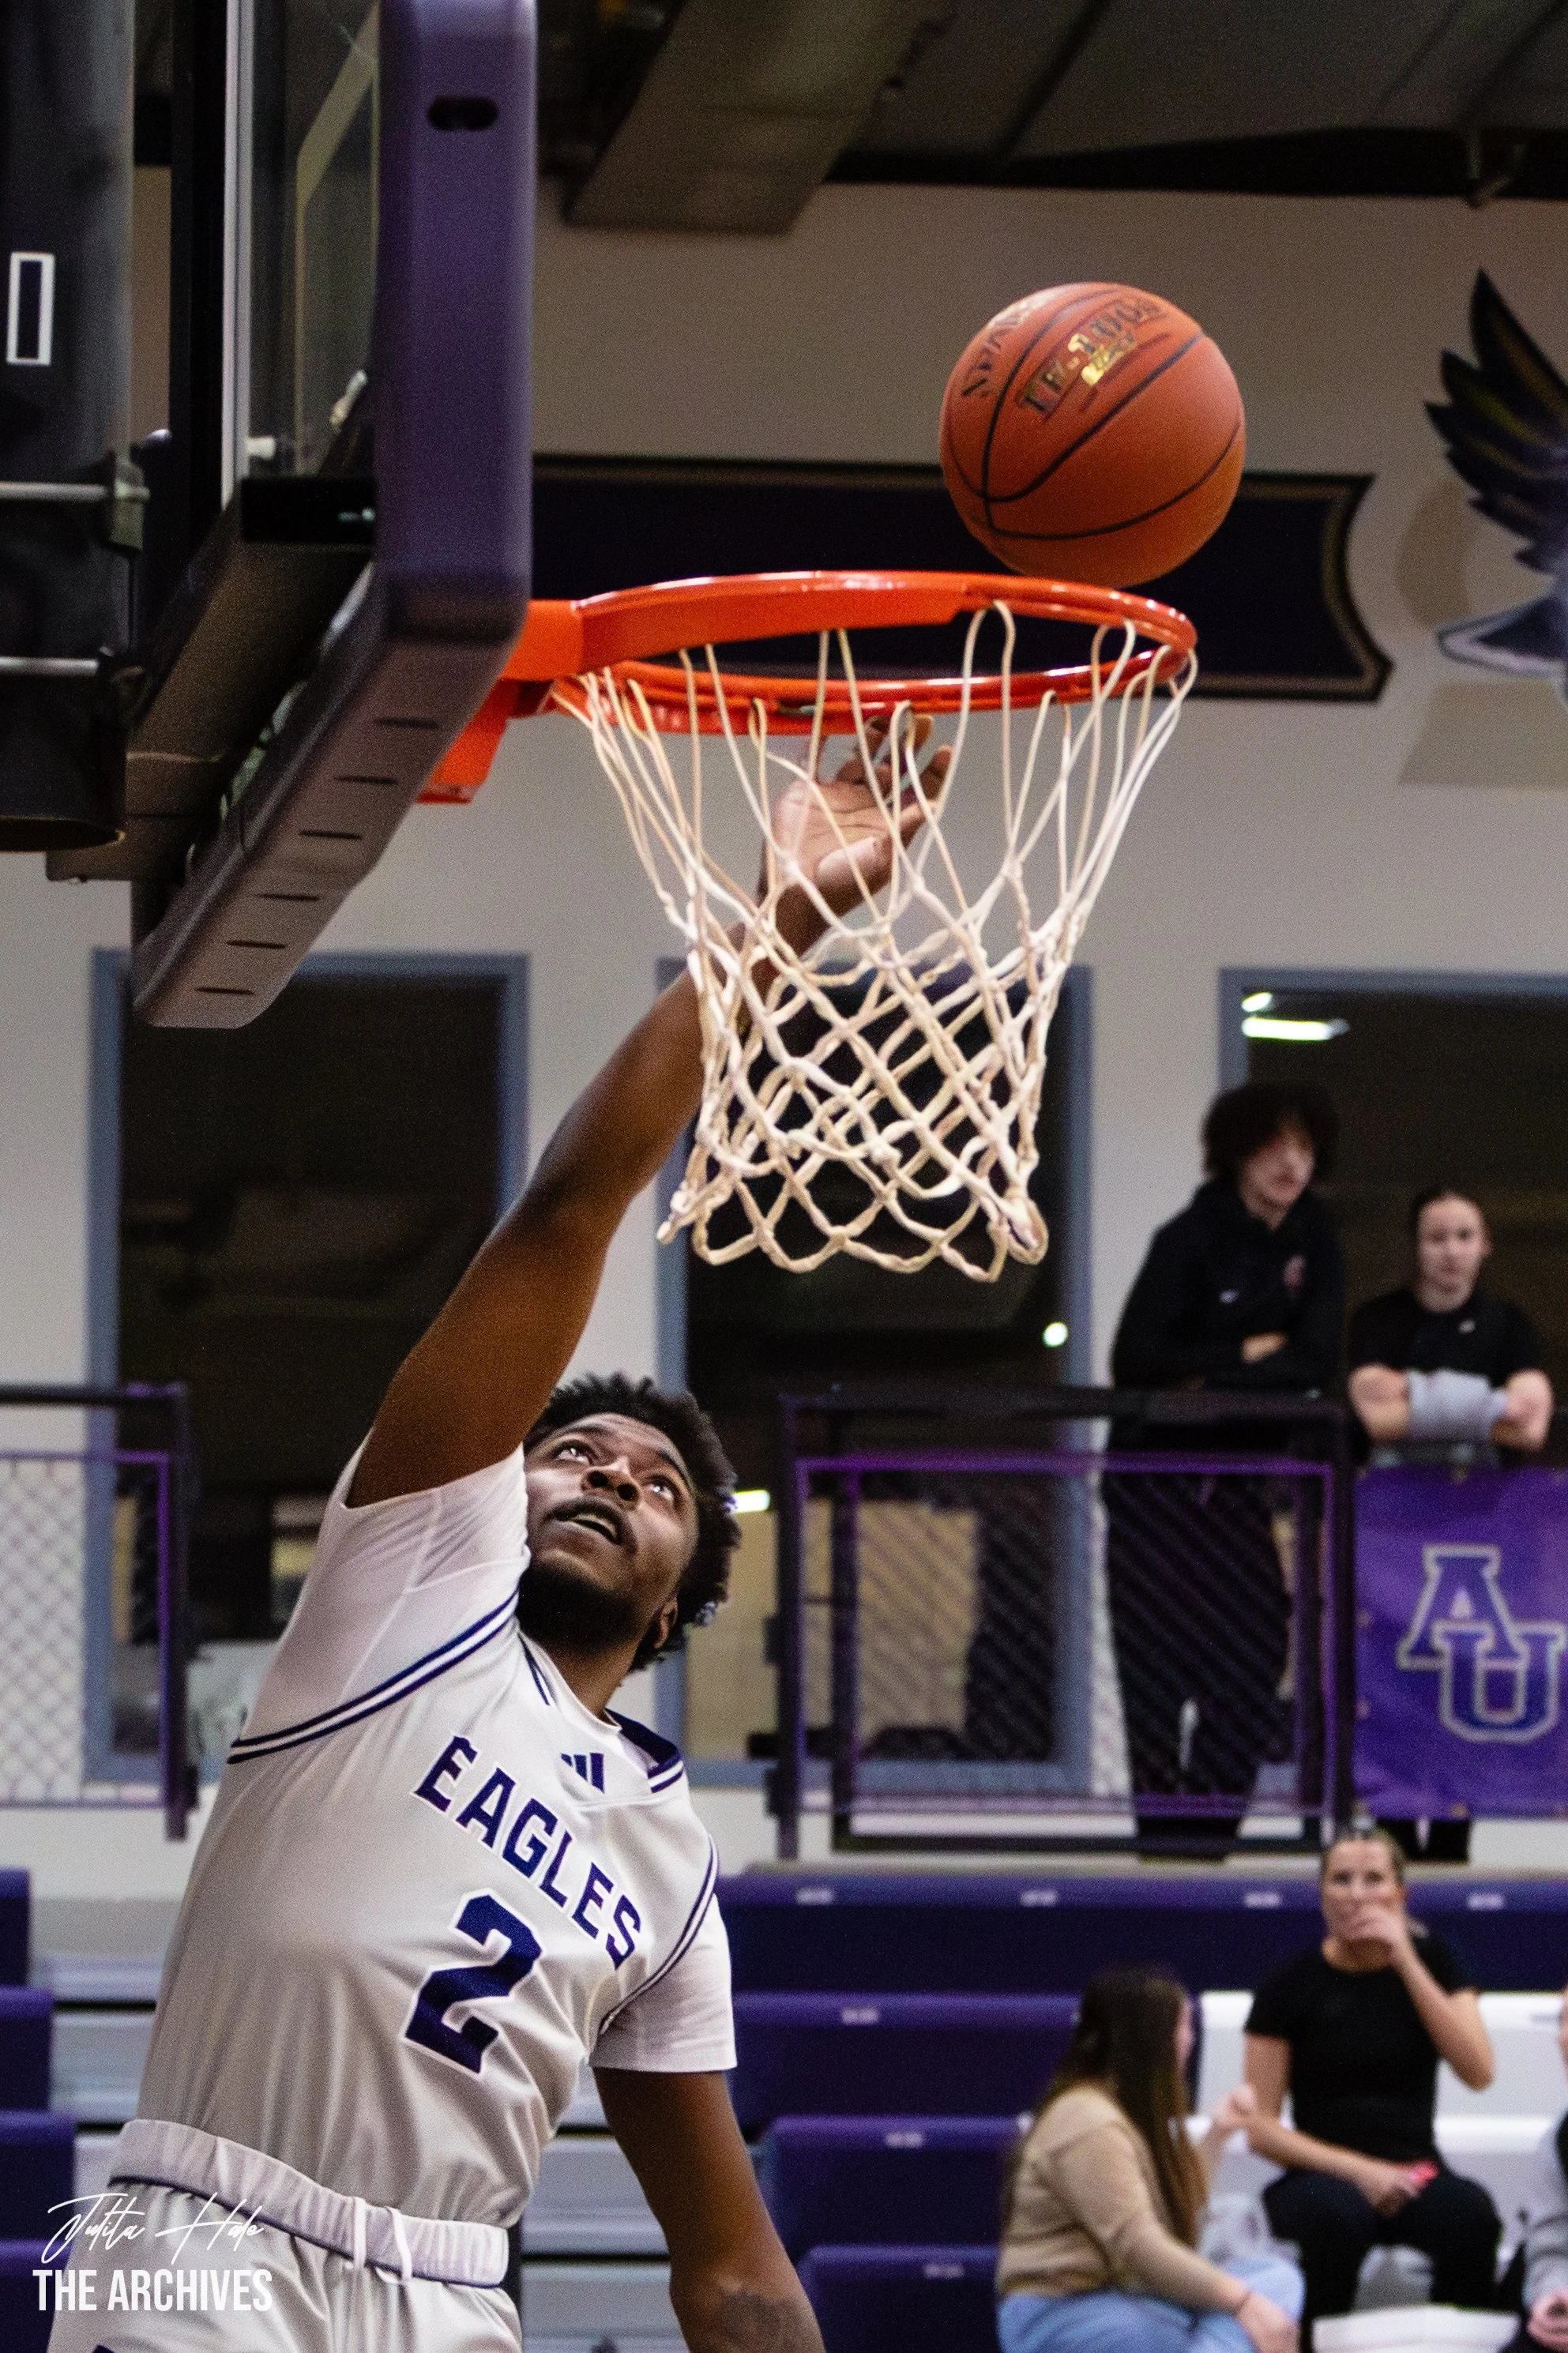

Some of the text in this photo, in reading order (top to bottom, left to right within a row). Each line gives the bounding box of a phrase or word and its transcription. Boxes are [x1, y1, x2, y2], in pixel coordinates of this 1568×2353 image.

[1395, 1542, 1566, 1742] AU
[412, 1735, 643, 1971] EAGLES
[404, 1887, 545, 2077] 2
